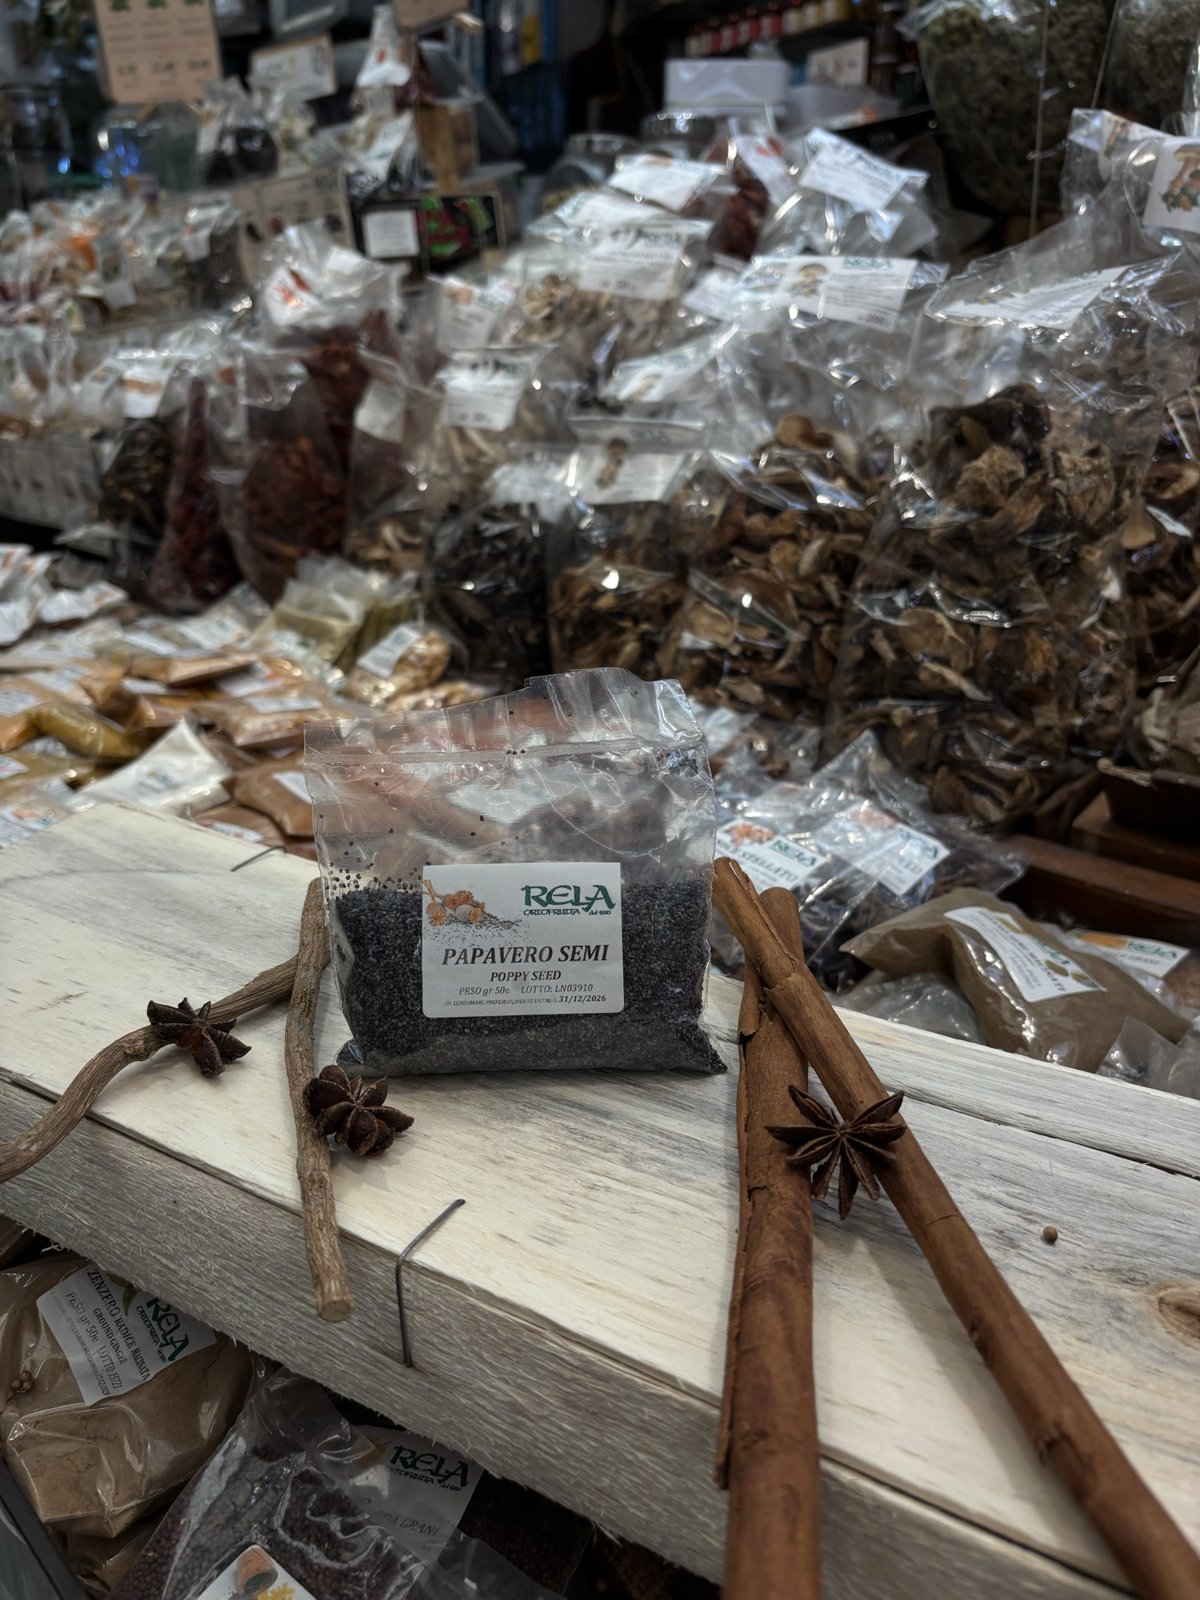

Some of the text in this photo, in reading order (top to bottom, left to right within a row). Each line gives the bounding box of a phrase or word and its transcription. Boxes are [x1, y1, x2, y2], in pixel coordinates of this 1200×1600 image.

[521, 885, 616, 912] RELA
[442, 945, 609, 965] PAPAVERO SEMI
[490, 970, 561, 982] POPPY SEED
[459, 987, 481, 995] PESO
[482, 988, 493, 996] gr
[521, 985, 552, 994] LOTTO:
[555, 984, 593, 993] LN03910
[559, 995, 607, 1003] 31/12/2026
[66, 1291, 85, 1315] PESO
[88, 1269, 120, 1317] ZENZERO
[115, 1314, 137, 1349] RADICE
[93, 1307, 128, 1365] GROUND GINGER
[146, 1297, 189, 1361] RELA
[390, 1445, 470, 1488] RELA
